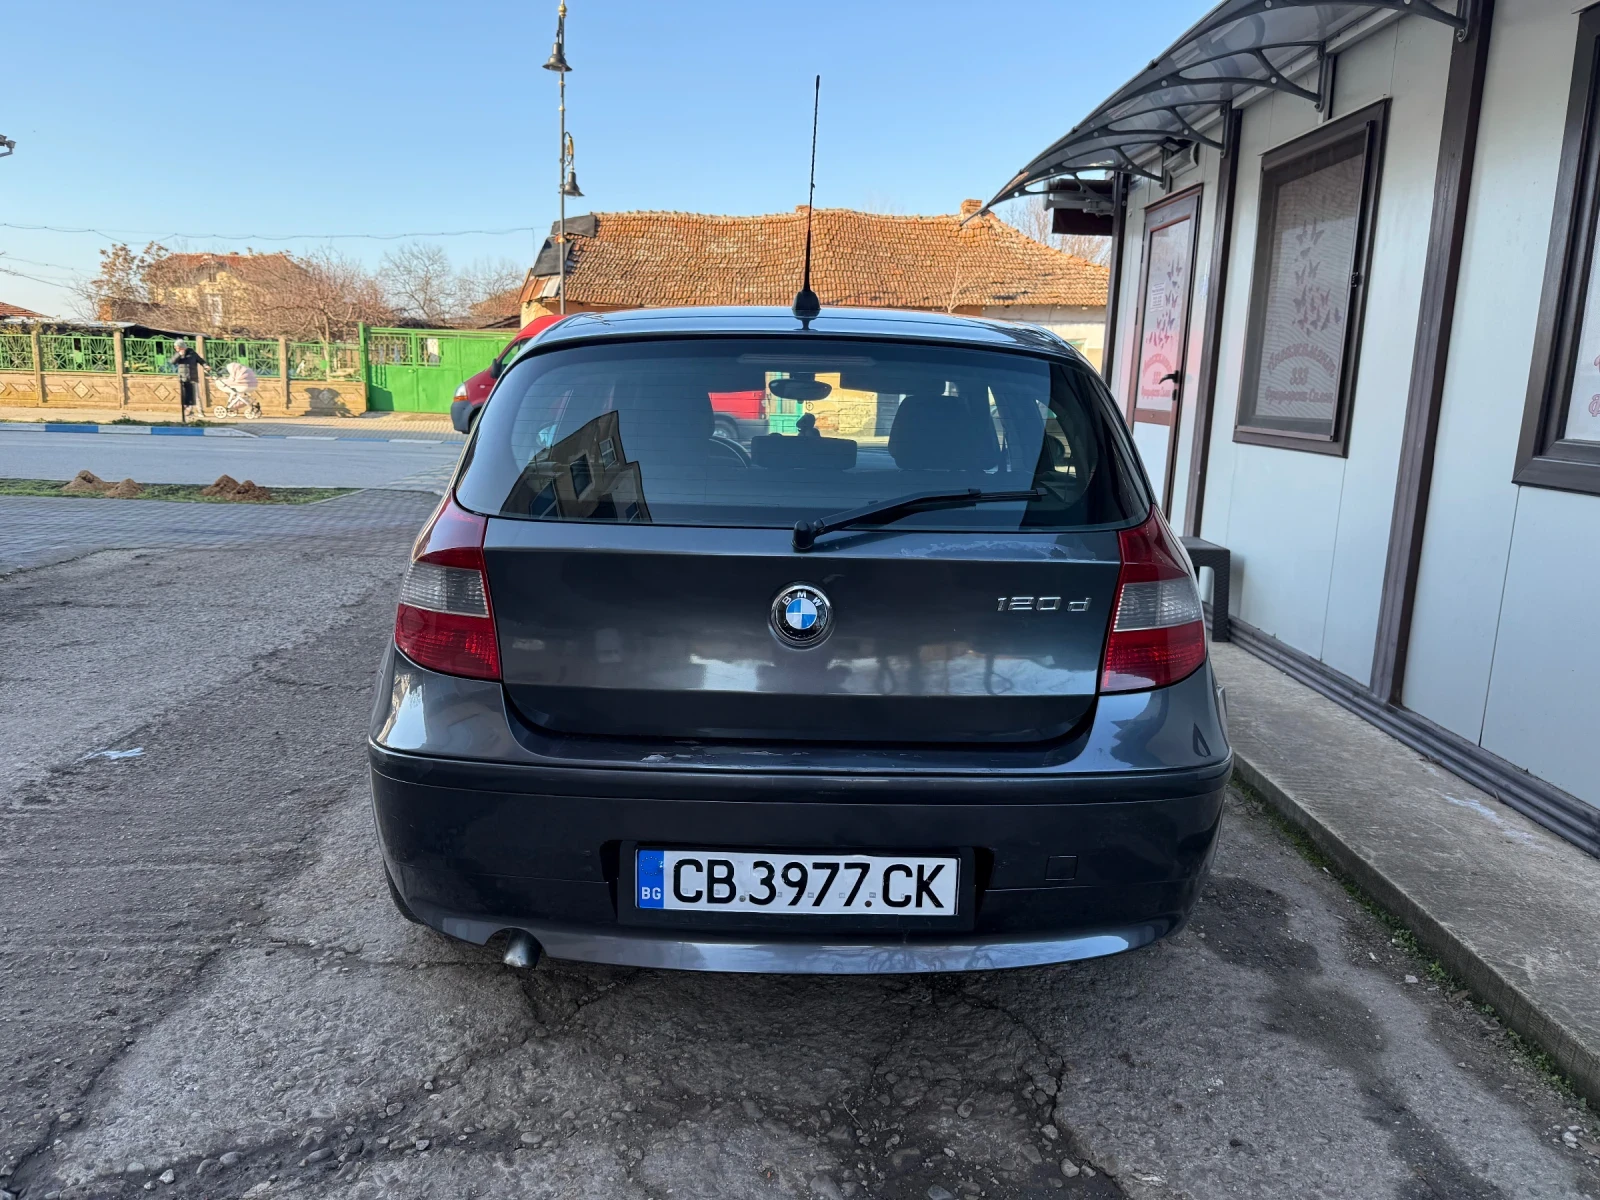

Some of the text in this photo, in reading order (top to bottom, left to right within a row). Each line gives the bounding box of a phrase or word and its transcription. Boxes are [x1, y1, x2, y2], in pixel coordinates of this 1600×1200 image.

[782, 590, 823, 606] BMW
[997, 596, 1061, 611] 120
[748, 860, 871, 907] 3977
[641, 887, 662, 900] BG
